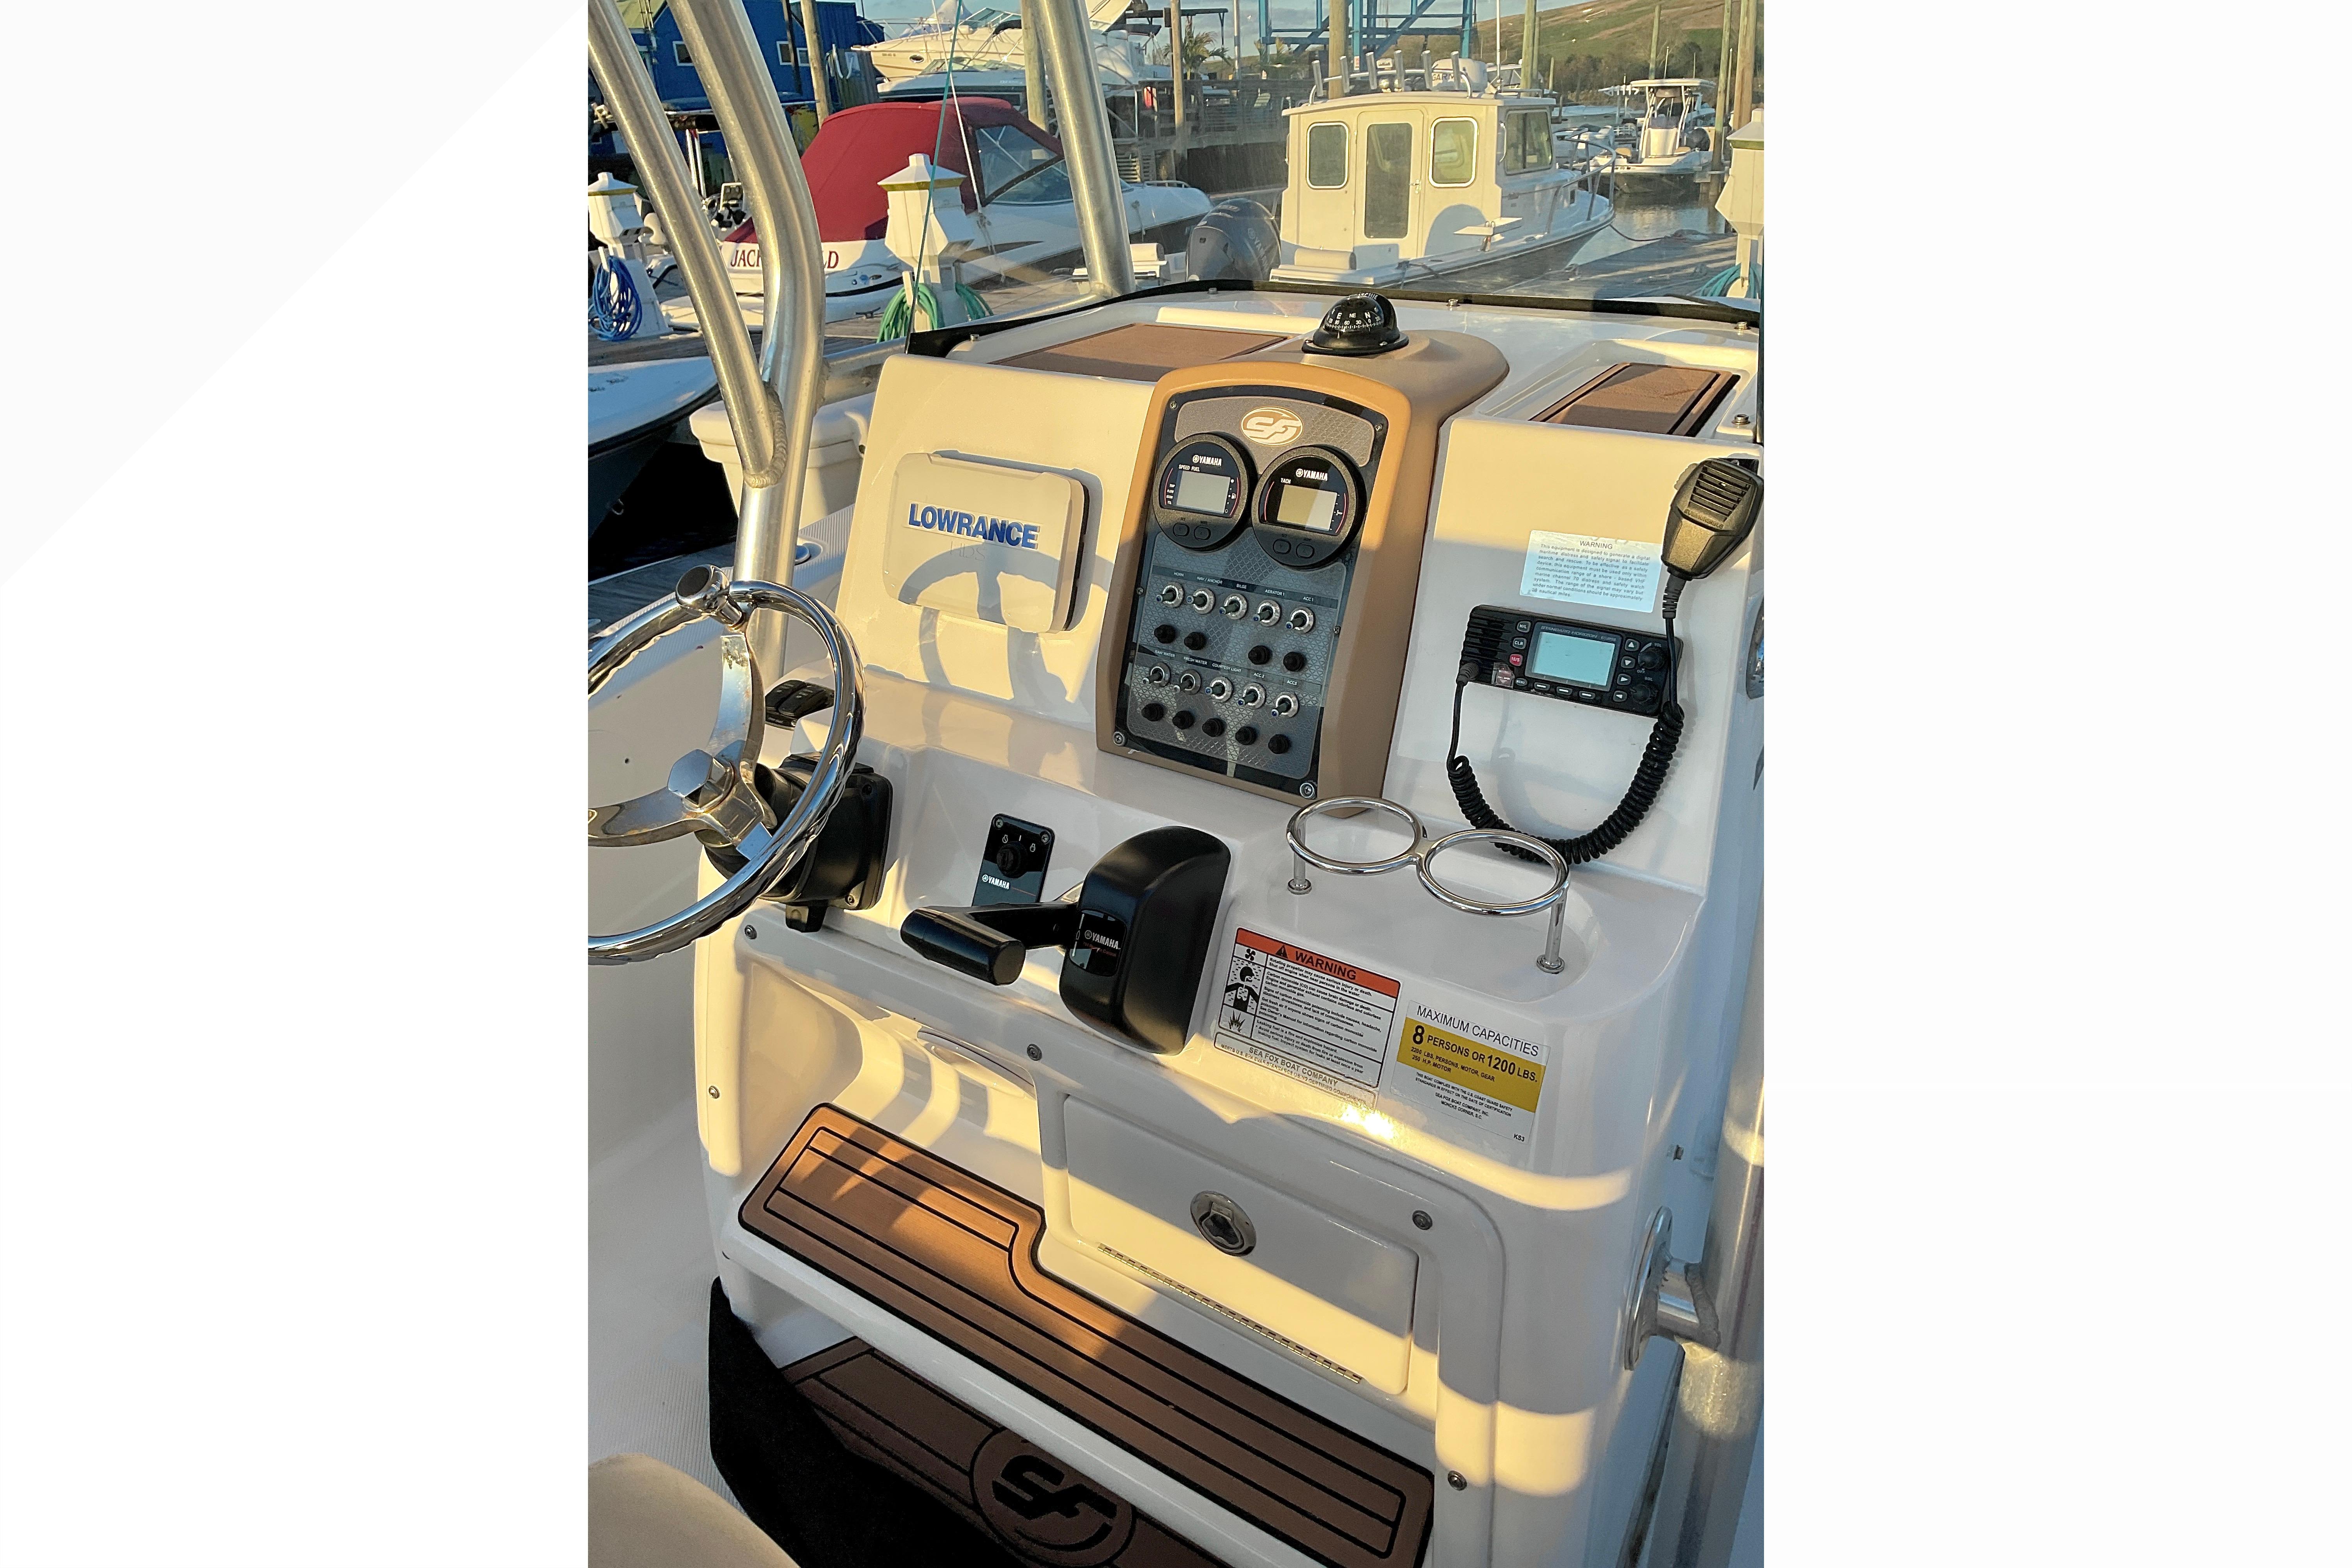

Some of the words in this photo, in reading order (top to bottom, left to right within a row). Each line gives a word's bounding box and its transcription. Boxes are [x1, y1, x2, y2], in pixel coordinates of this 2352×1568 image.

[730, 250, 760, 267] JAC
[1199, 456, 1222, 466] YAMAHA
[1304, 469, 1328, 481] YAMAHA
[909, 503, 1040, 550] LOWRANCE
[1579, 540, 1613, 549] WARNING
[1610, 593, 1642, 601] approximately
[988, 876, 1010, 890] YAMAHA
[1092, 933, 1118, 949] YAMAHA
[1294, 950, 1357, 981] WARNING
[1416, 1005, 1470, 1032] MAXIMUM
[1471, 1025, 1539, 1057] CAPACITIES
[1412, 1024, 1426, 1046] 8
[1427, 1035, 1470, 1057] PERSONS
[1471, 1051, 1486, 1063] OR
[1486, 1054, 1516, 1075] 1200
[1517, 1067, 1538, 1082] LBS.
[1249, 1047, 1264, 1058] SEA
[1264, 1053, 1279, 1064] FOX
[1281, 1059, 1300, 1072] BOAT
[1301, 1068, 1338, 1087] COMPANY
[1411, 1046, 1422, 1055] 2200
[1480, 1072, 1495, 1082] GEAR
[1433, 1062, 1451, 1073] MOTOR
[1513, 1133, 1525, 1142] KS3
